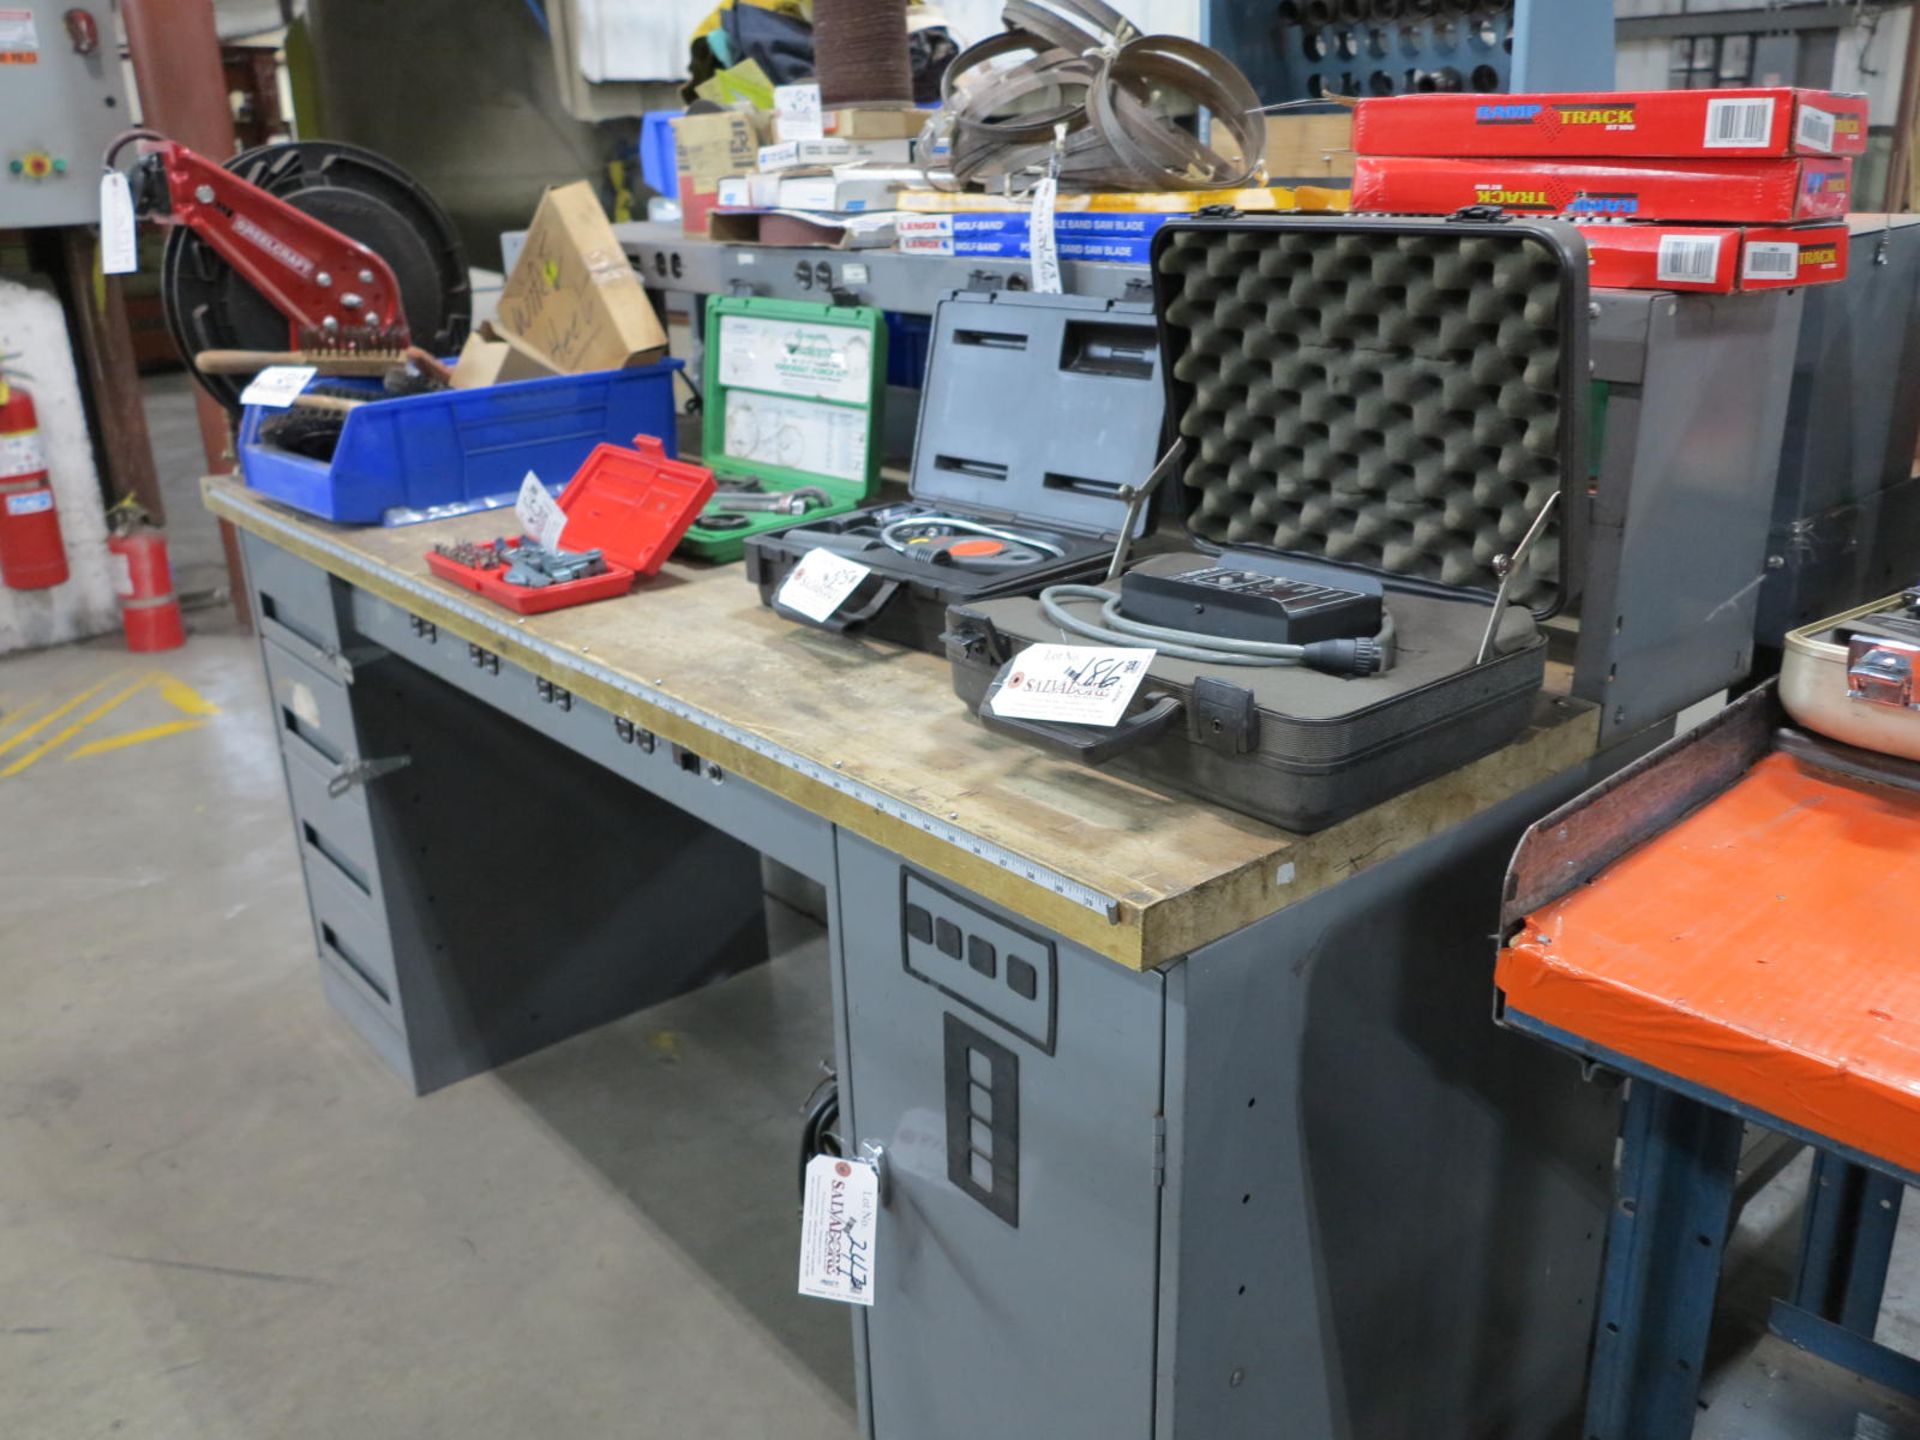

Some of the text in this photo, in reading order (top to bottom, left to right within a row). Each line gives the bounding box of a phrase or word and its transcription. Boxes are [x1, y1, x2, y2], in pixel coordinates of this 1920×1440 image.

[1476, 104, 1633, 124] RAMP TRACK
[1477, 190, 1639, 213] RAMP TRACK
[899, 221, 937, 231] LENOX
[1068, 219, 1092, 230] BAND
[1094, 219, 1113, 230] SAW
[1115, 220, 1145, 232] BLADE
[905, 239, 939, 249] LENOX
[1105, 245, 1132, 257] BLADE
